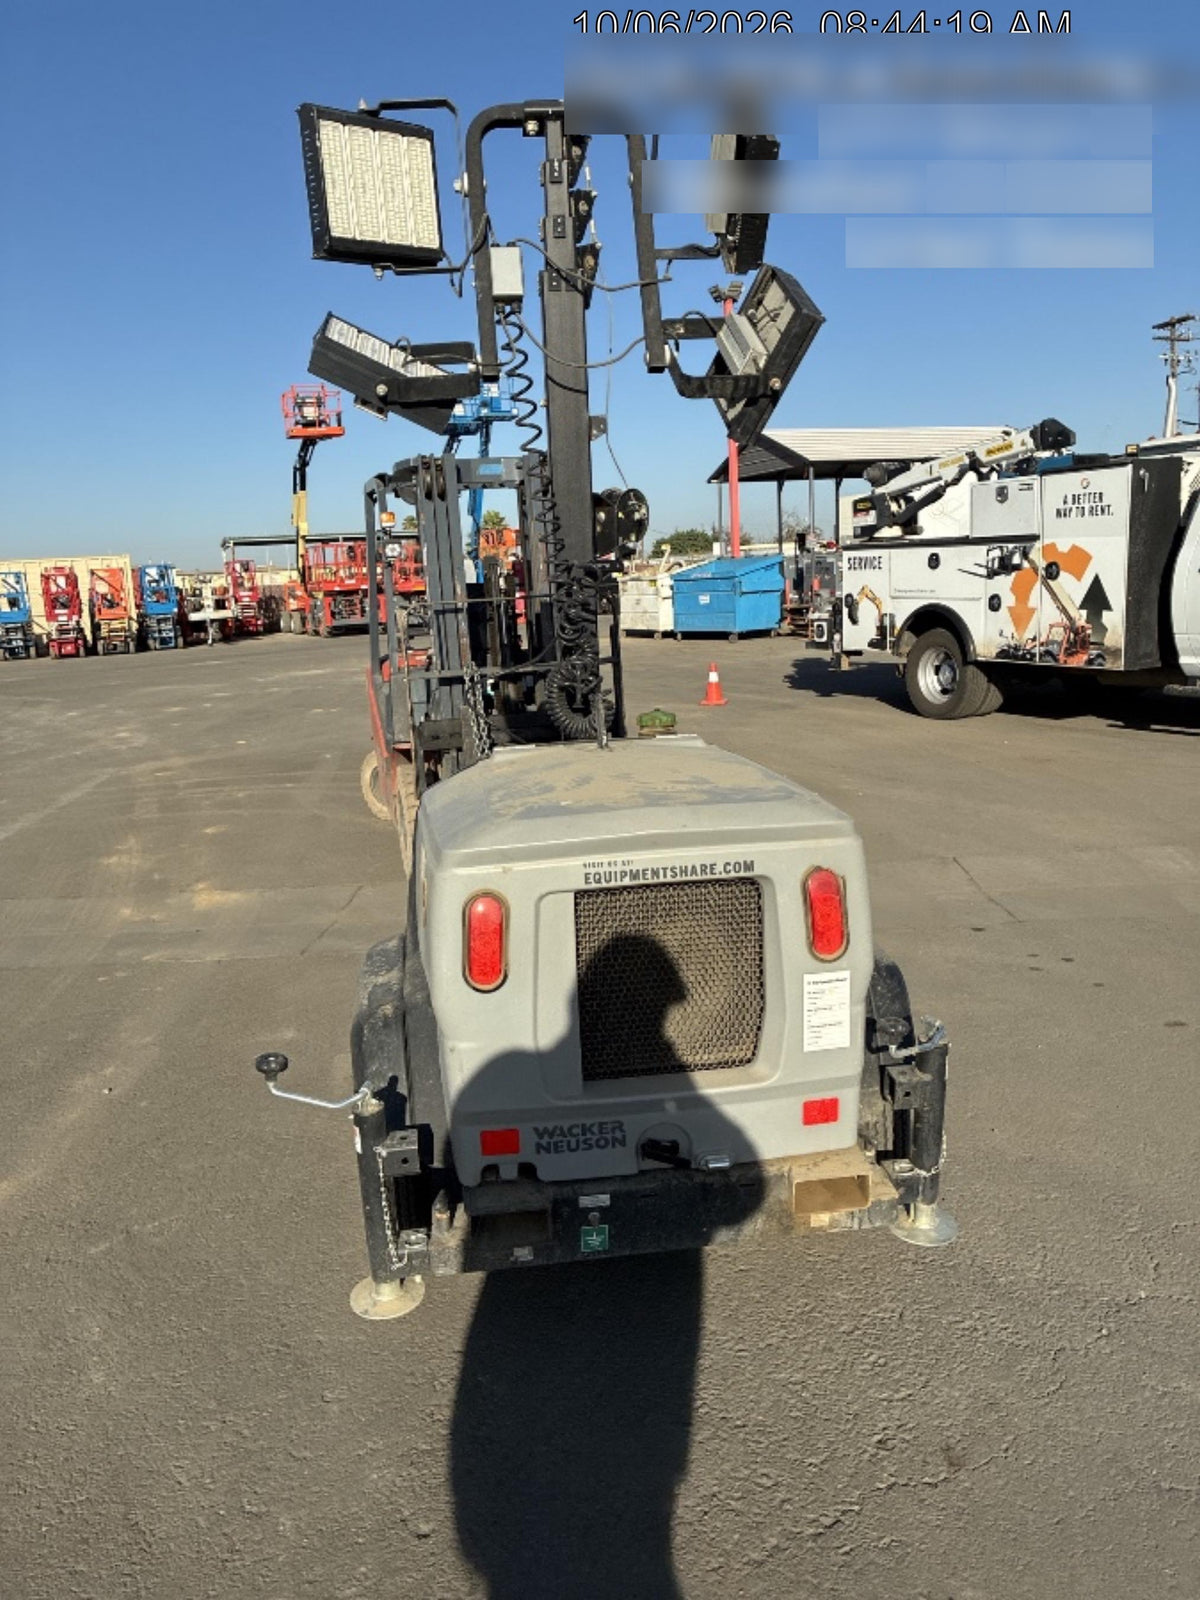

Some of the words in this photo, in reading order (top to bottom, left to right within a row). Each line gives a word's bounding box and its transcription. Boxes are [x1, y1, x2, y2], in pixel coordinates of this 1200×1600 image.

[1063, 493, 1069, 506] A
[1071, 491, 1104, 505] BETTER
[1056, 507, 1073, 518] WAY
[1075, 506, 1086, 518] TO
[1088, 504, 1114, 517] RENT.
[847, 555, 883, 571] SERVICE
[584, 859, 756, 885] EQUIPMENTSHARE.COM
[532, 1120, 627, 1140] WACKER
[534, 1133, 627, 1155] NEUSON
